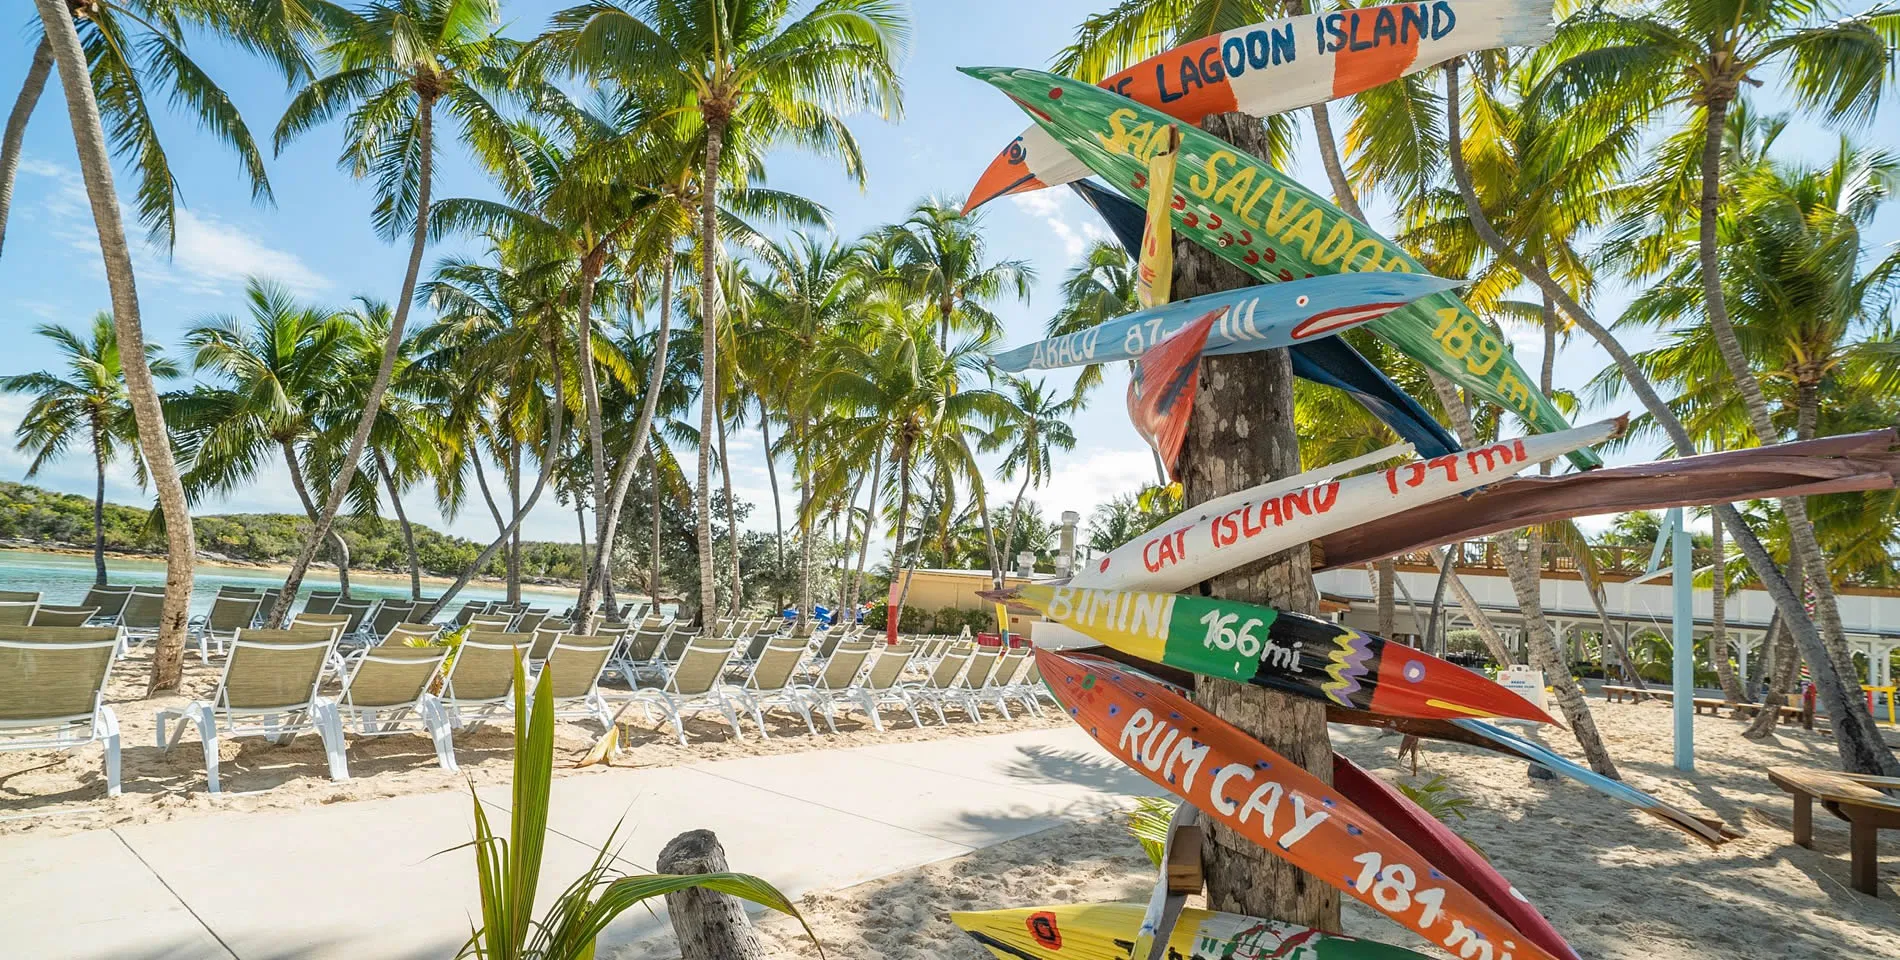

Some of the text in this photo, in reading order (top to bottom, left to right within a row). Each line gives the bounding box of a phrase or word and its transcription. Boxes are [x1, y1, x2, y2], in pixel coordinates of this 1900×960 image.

[1155, 22, 1296, 103] LAGOON
[1316, 1, 1456, 55] ISLAND
[1124, 318, 1163, 355] 87
[1431, 307, 1502, 376] 189
[1143, 525, 1194, 573] CAT
[1212, 482, 1340, 549] ISLAND
[1048, 586, 1303, 673] BIMINI 166 mi
[1119, 708, 1210, 794] RUM
[1210, 763, 1331, 849] CAY
[1353, 852, 1446, 929] 181
